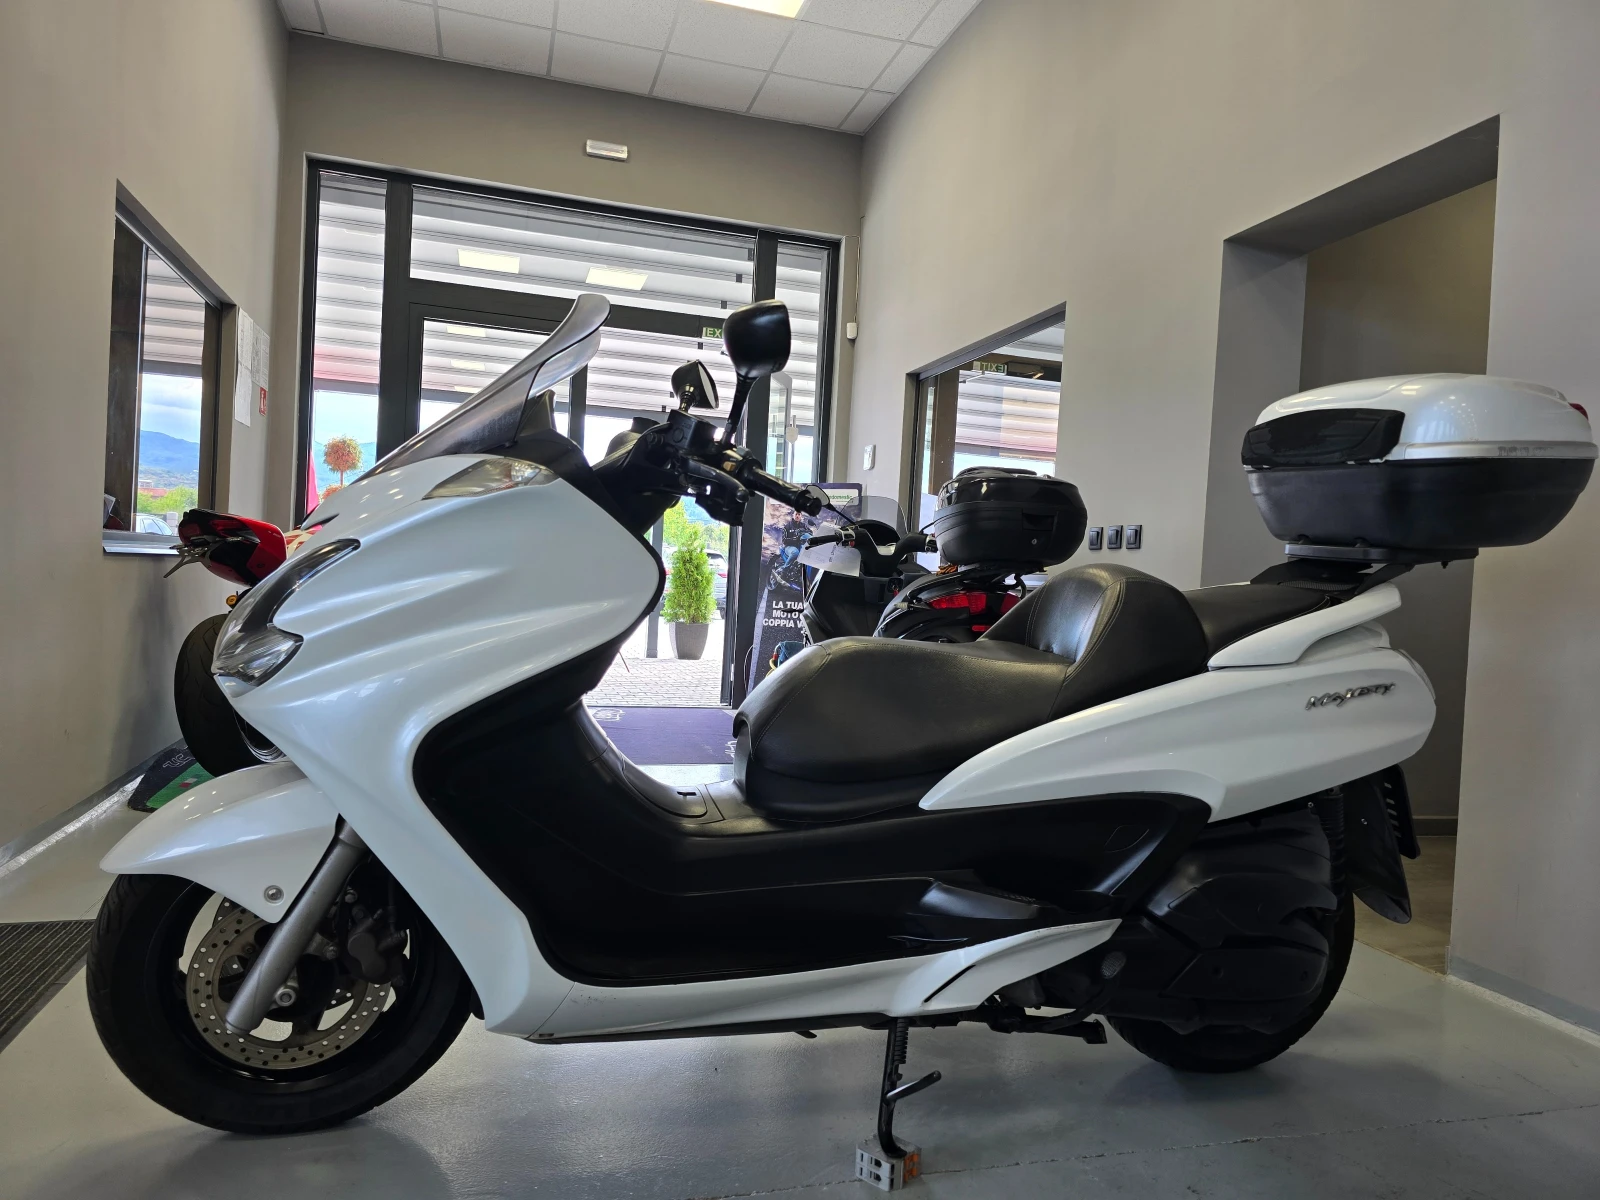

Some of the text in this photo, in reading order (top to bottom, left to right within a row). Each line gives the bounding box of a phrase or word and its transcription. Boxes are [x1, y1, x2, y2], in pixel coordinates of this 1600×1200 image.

[706, 328, 721, 338] EX
[772, 610, 799, 619] MOTO
[763, 619, 795, 627] COPPIA
